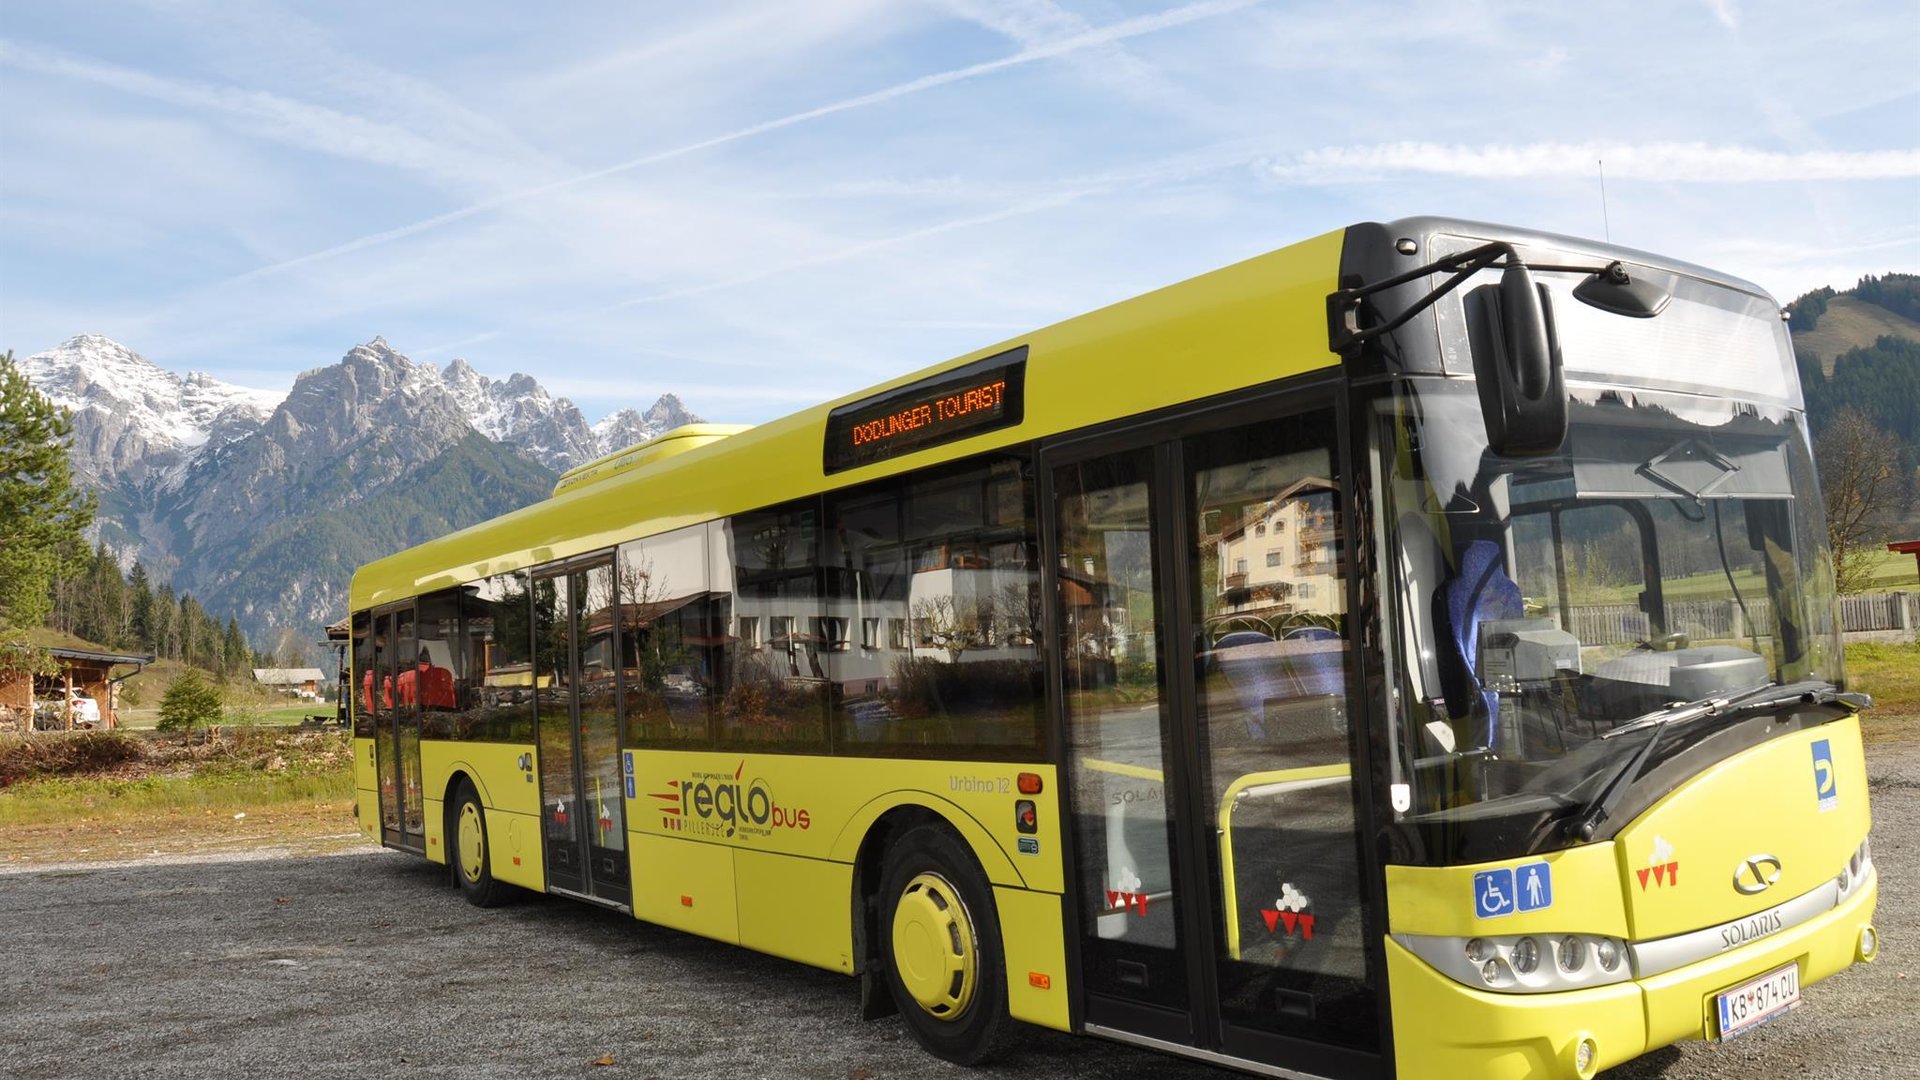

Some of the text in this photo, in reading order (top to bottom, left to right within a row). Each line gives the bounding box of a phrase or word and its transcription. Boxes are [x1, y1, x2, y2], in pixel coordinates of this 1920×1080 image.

[853, 405, 932, 445] DÖDLINGER
[949, 776, 1010, 794] Urbino 12
[1636, 861, 1678, 893] VVT
[1106, 889, 1148, 917] VVT
[1260, 909, 1314, 941] VVT
[1721, 911, 1782, 949] SOLARIS
[1731, 994, 1747, 1022] KB
